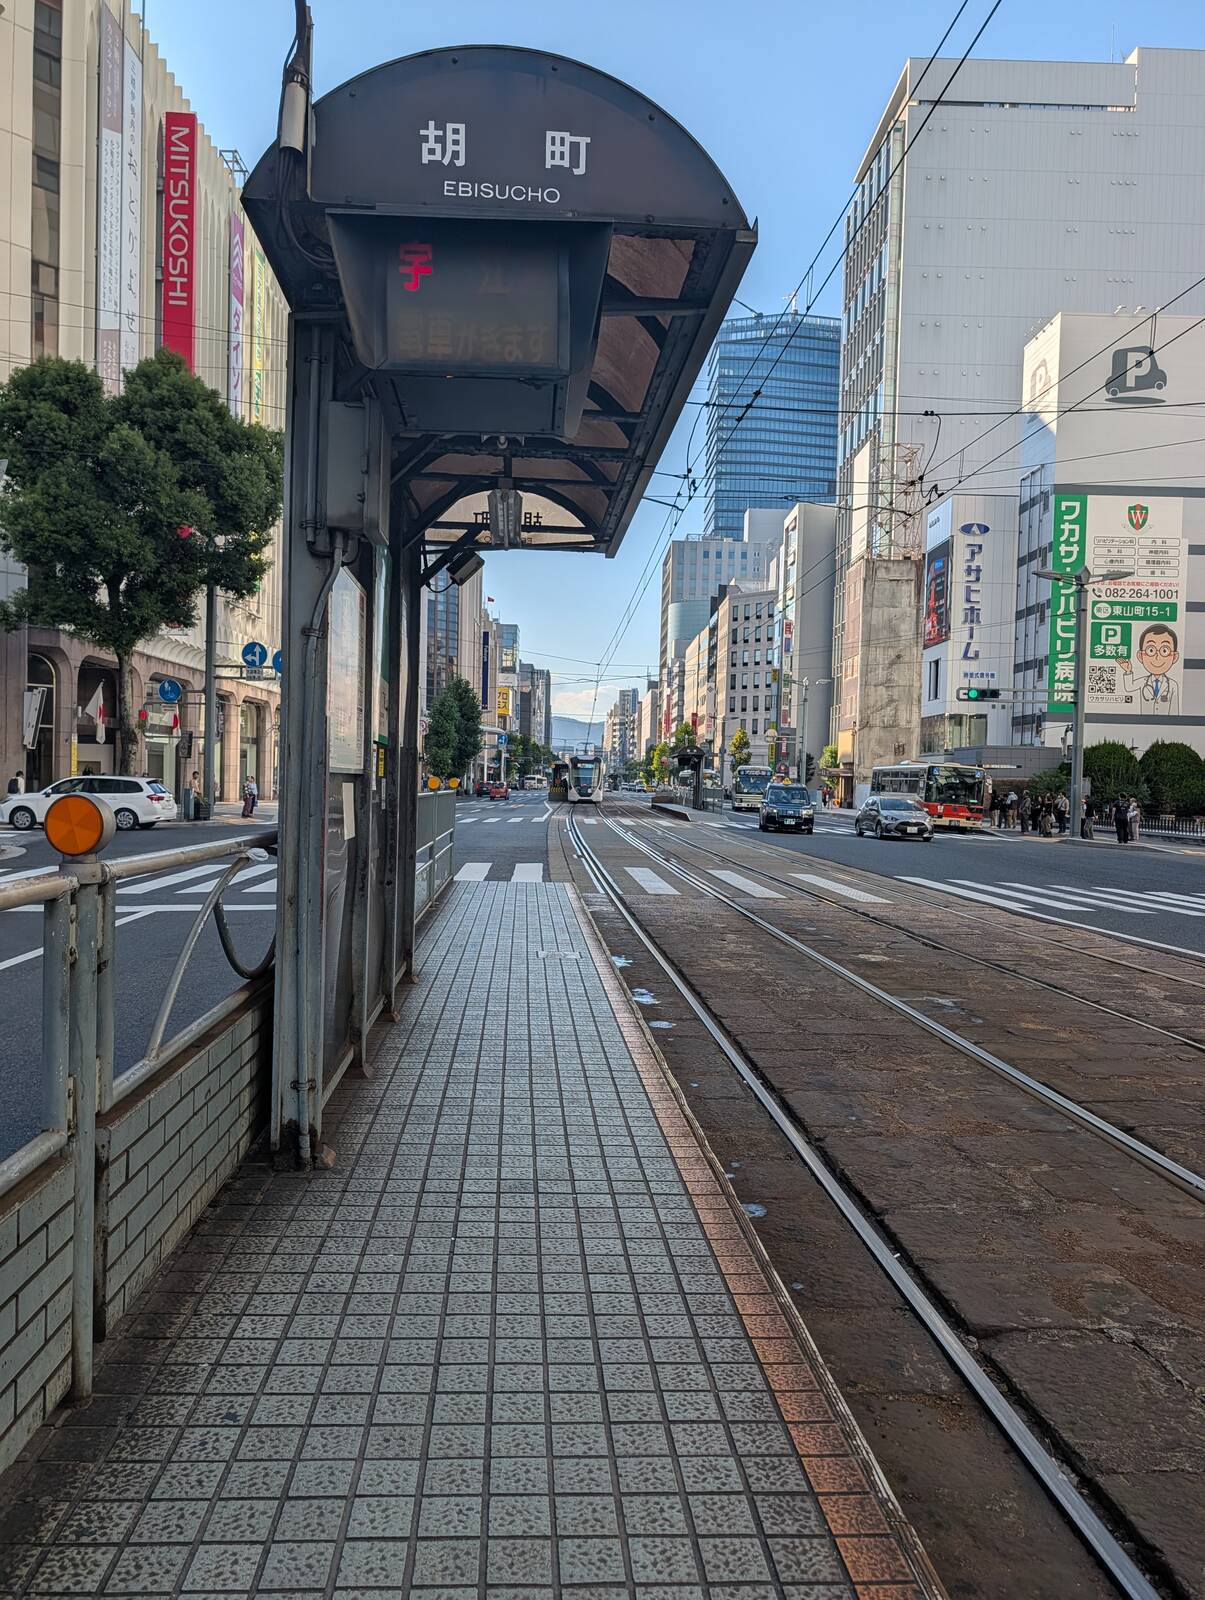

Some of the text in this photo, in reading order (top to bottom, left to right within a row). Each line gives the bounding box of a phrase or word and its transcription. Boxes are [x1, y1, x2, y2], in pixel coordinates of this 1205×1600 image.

[443, 180, 561, 203] EBISUCHO
[168, 125, 191, 306] MITSUKOSHI
[962, 543, 983, 661] アサヒホーム
[1104, 588, 1179, 599] 082-264-1001
[1112, 605, 1171, 617] 東山町15-1
[1094, 644, 1128, 656] 多数有
